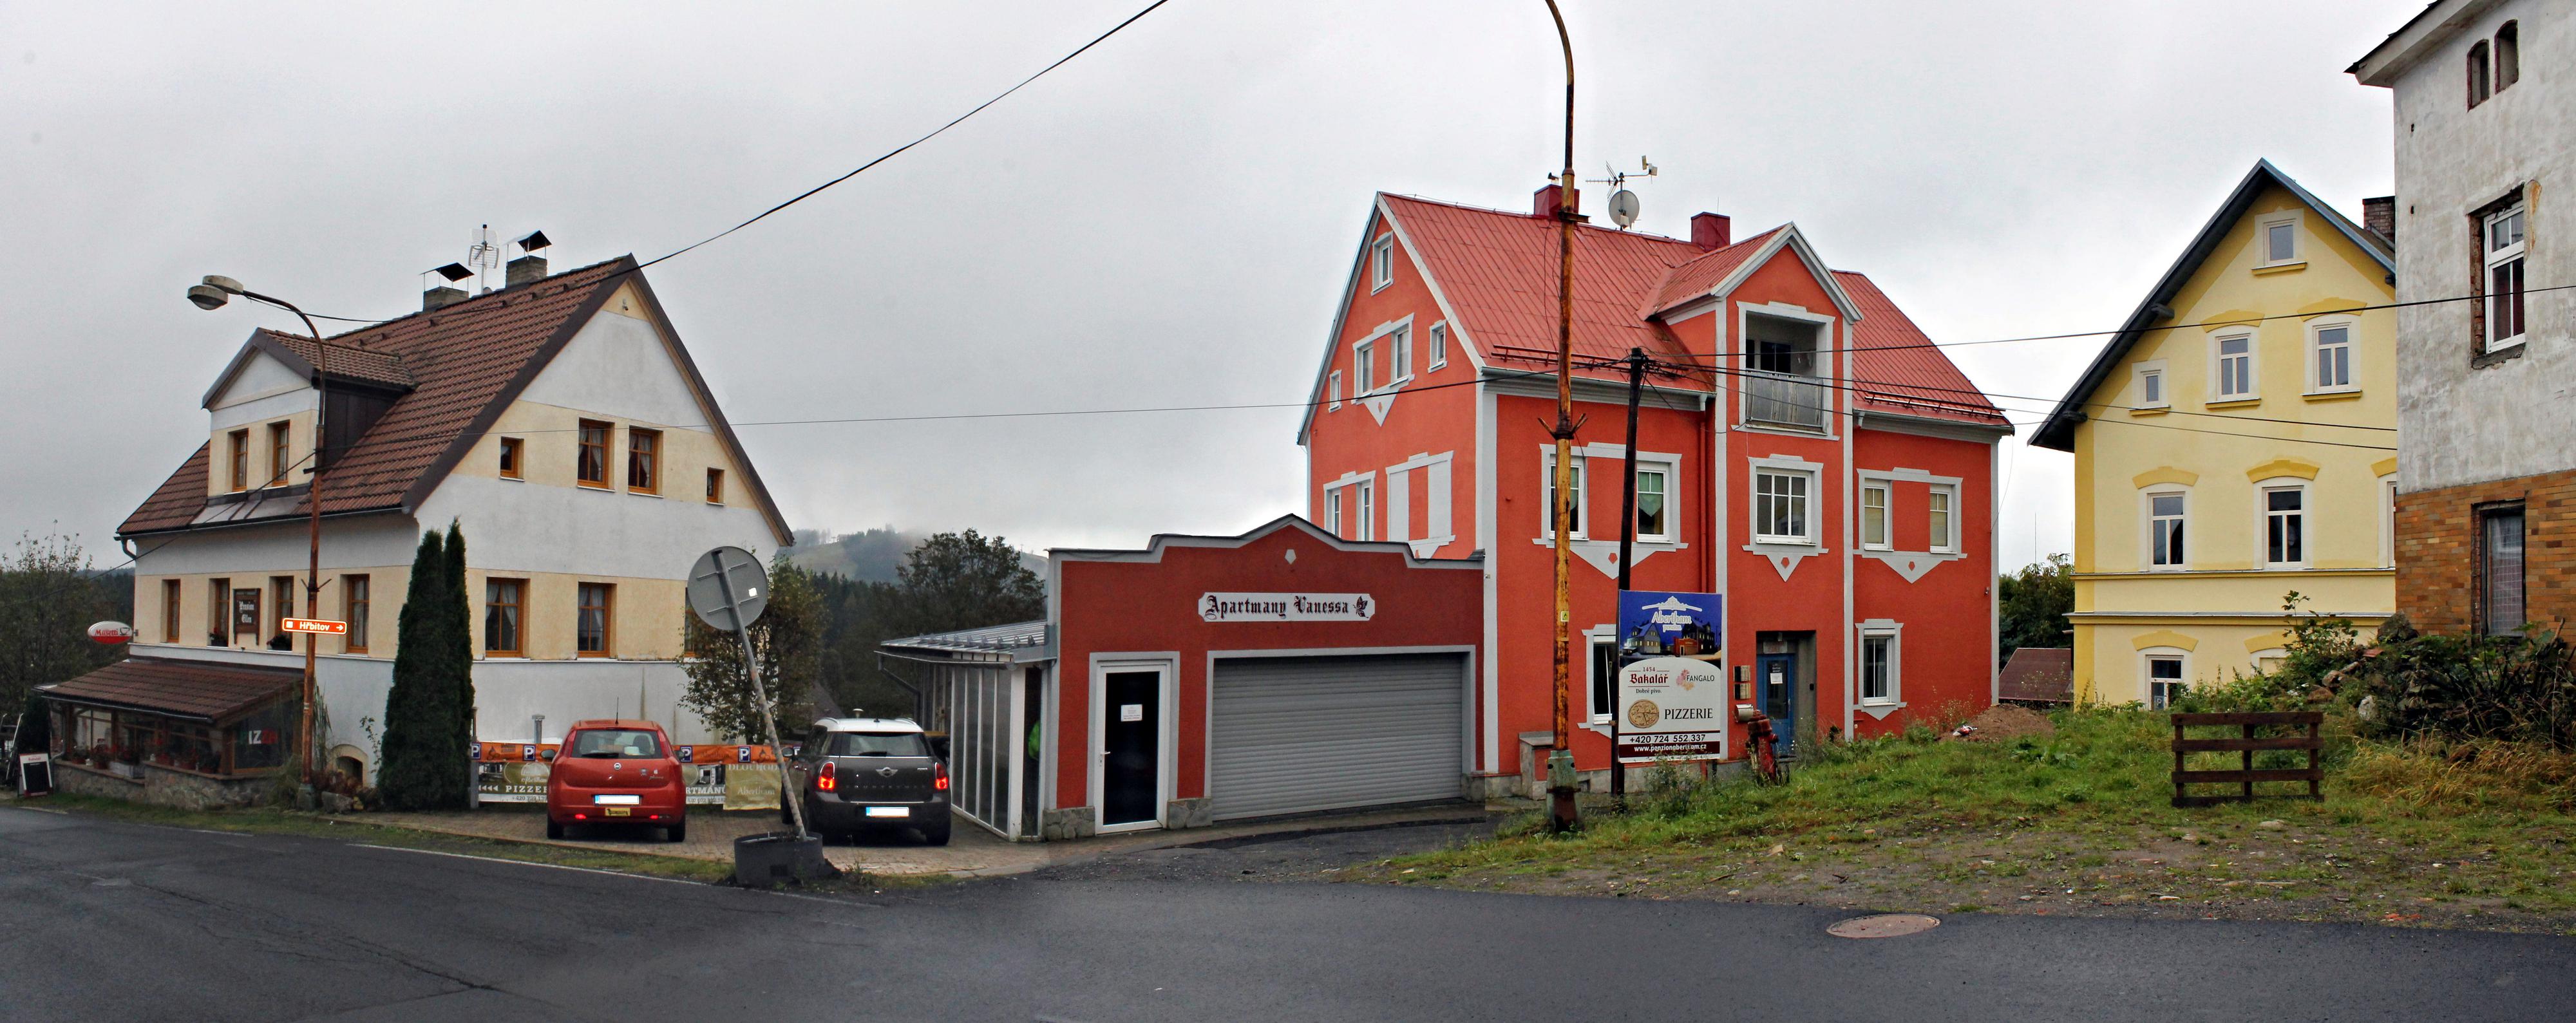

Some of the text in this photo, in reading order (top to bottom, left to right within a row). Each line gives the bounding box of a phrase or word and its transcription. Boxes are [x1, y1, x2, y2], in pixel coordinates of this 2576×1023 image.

[1205, 595, 1349, 620] Apartmany Vanessa
[1651, 610, 1692, 624] Abertham
[299, 621, 330, 631] Hřbitov
[1629, 673, 1669, 684] Bakalář
[1664, 708, 1714, 720] PIZZERIE
[1630, 735, 1651, 744] +420
[471, 745, 479, 759] P
[525, 747, 534, 758] P
[740, 749, 749, 760] P
[737, 785, 775, 795] Abertham
